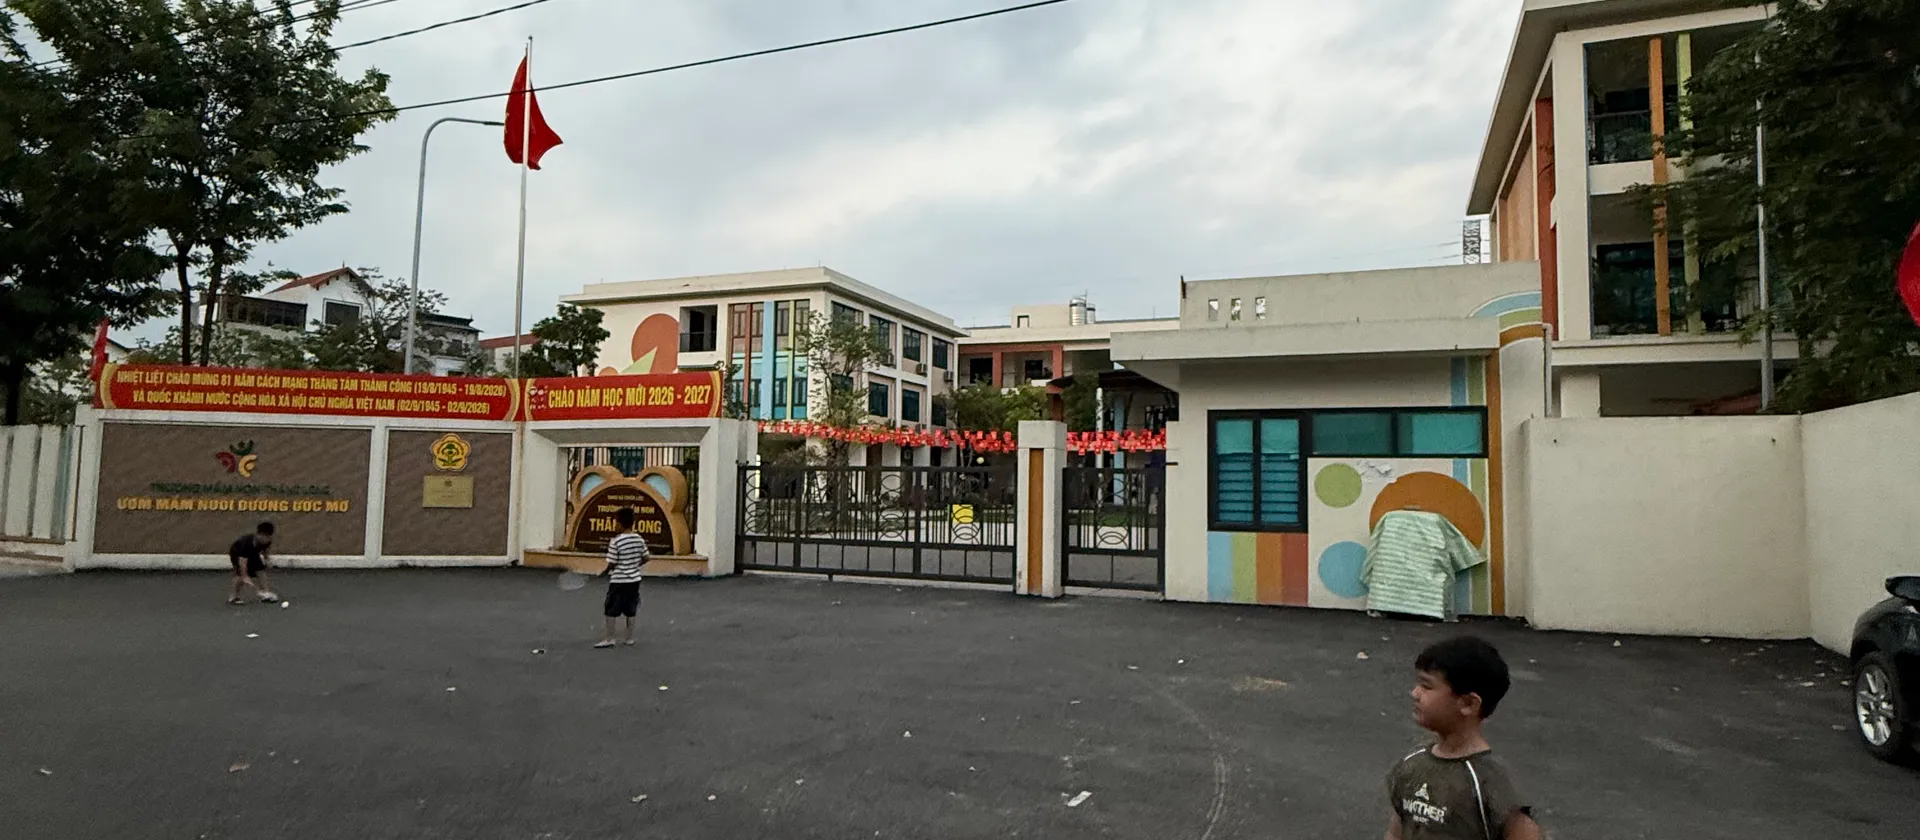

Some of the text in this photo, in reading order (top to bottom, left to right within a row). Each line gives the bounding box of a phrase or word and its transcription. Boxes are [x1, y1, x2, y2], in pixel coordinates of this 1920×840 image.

[117, 370, 143, 386] NHIỆT
[146, 370, 164, 386] LIỆT
[166, 370, 190, 385] CHÀO
[192, 371, 219, 386] MỪNG
[221, 374, 231, 386] 81
[234, 373, 255, 388] NĂM
[256, 374, 280, 388] CÁCH
[282, 376, 308, 391] MẠNG
[310, 376, 338, 390] THÁNG
[340, 376, 358, 391] TÁM
[360, 377, 387, 392] THÀNH
[390, 378, 412, 394] CÔNG
[414, 381, 457, 395] (19/8/1945
[464, 384, 506, 398] 19/8/2026)
[133, 388, 145, 403] VÀ
[147, 387, 171, 404] QUỐC
[173, 390, 204, 404] KHÁNH
[206, 390, 230, 405] NƯỚC
[232, 391, 256, 407] CỘNG
[258, 392, 276, 406] HÒA
[278, 392, 290, 407] XÃ
[292, 393, 307, 409] HỘI
[308, 393, 326, 408] CHỦ
[328, 395, 354, 409] NGHĨA
[356, 396, 374, 412] VIỆT
[376, 398, 395, 410] NAM
[548, 385, 574, 408] CHÀO
[576, 385, 600, 408] NĂM
[602, 388, 623, 411] HỌC
[626, 383, 645, 406] MỚI
[648, 386, 674, 406] 2026
[684, 385, 711, 405] 2027
[597, 504, 622, 513] TRƯỜN
[589, 516, 662, 534] THĂ LONG
